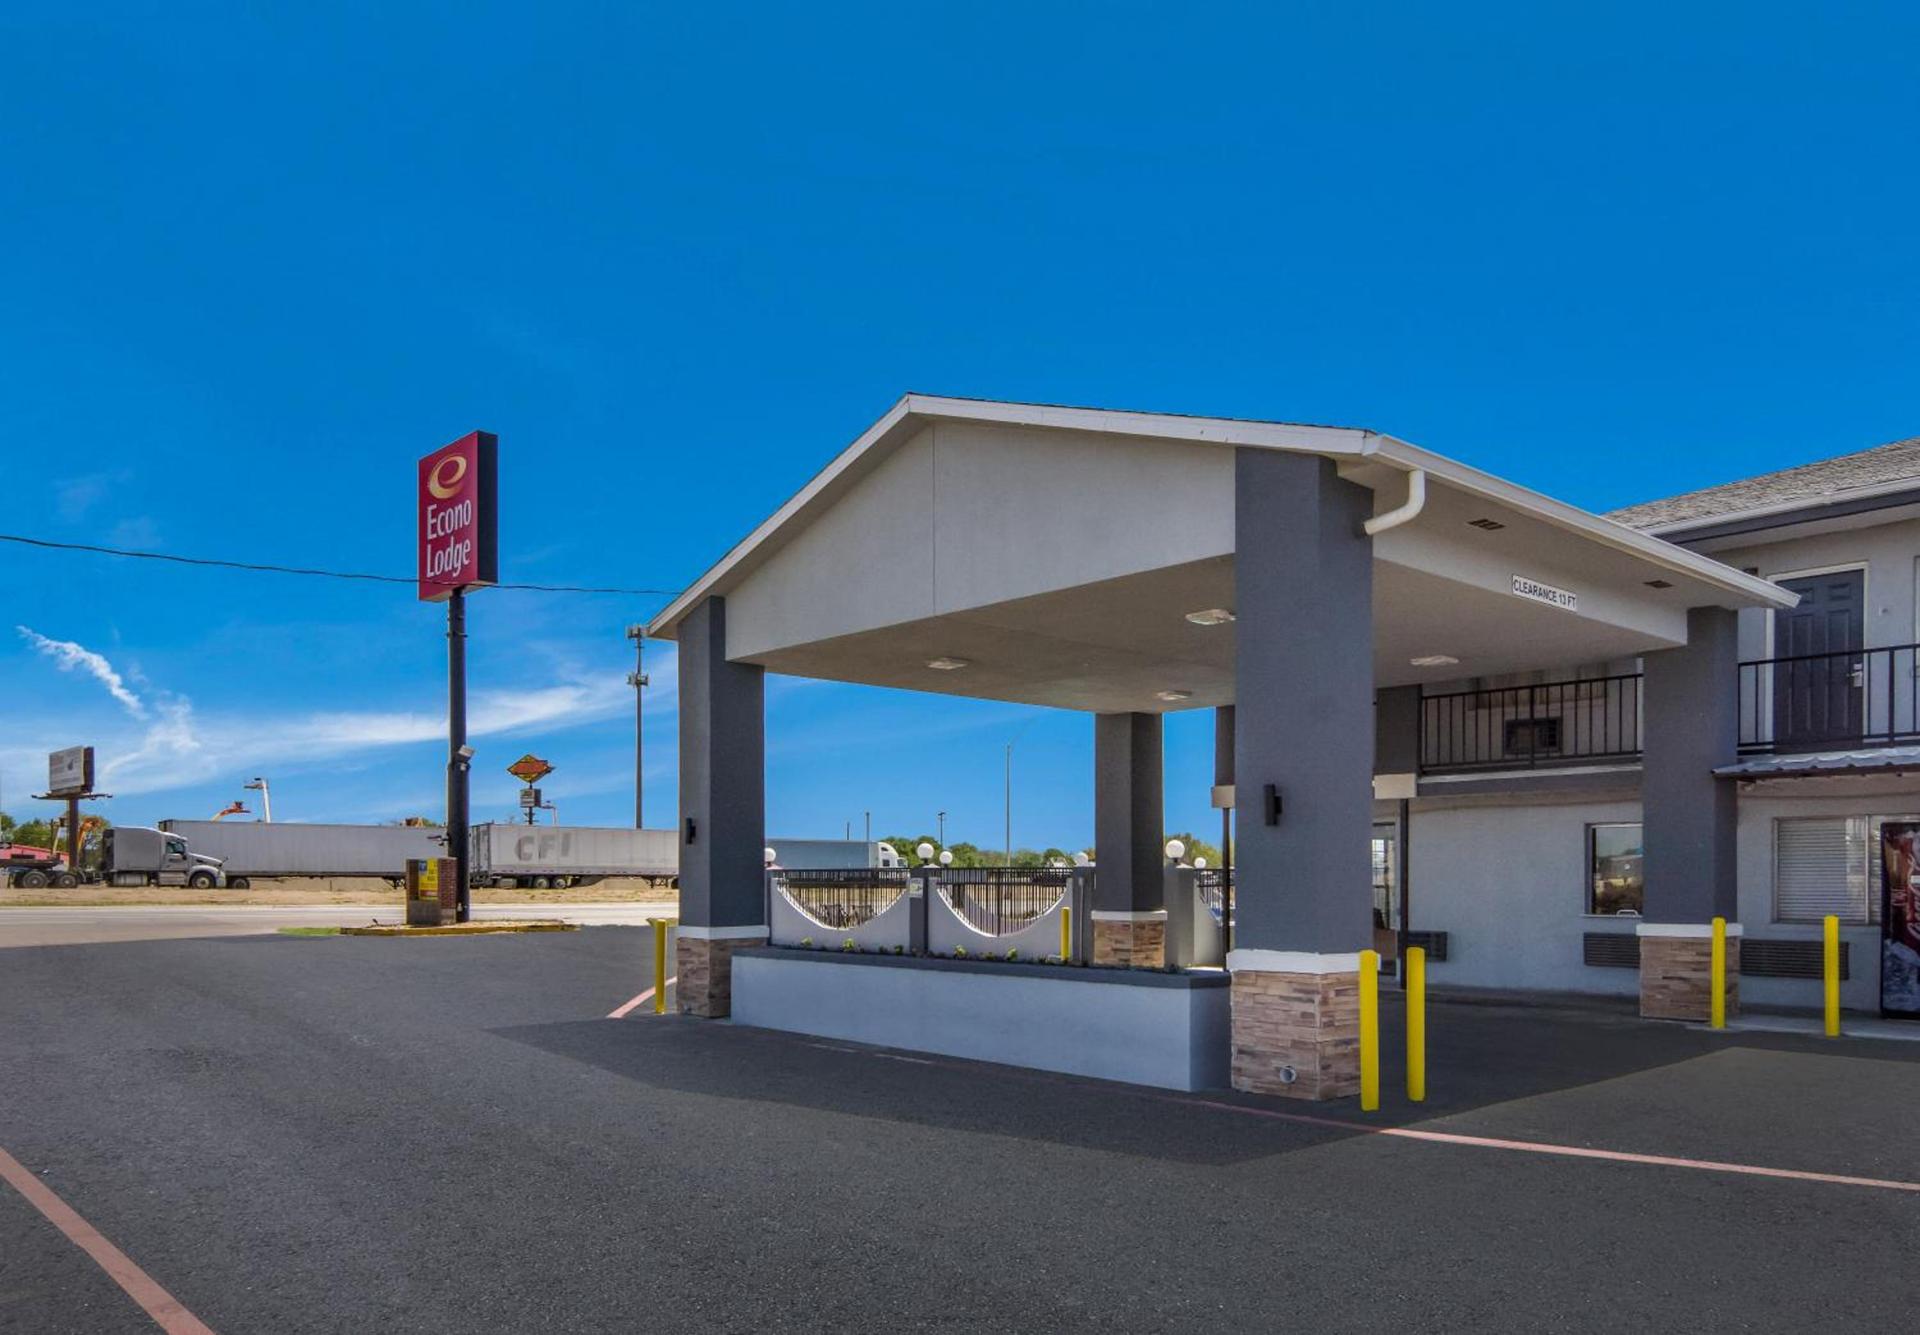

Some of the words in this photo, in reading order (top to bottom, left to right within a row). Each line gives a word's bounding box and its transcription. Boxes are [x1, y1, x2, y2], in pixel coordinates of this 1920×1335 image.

[426, 500, 472, 540] Econo
[426, 536, 471, 577] Lodge
[1513, 579, 1557, 603] CLEARANCE
[1568, 595, 1576, 608] FT
